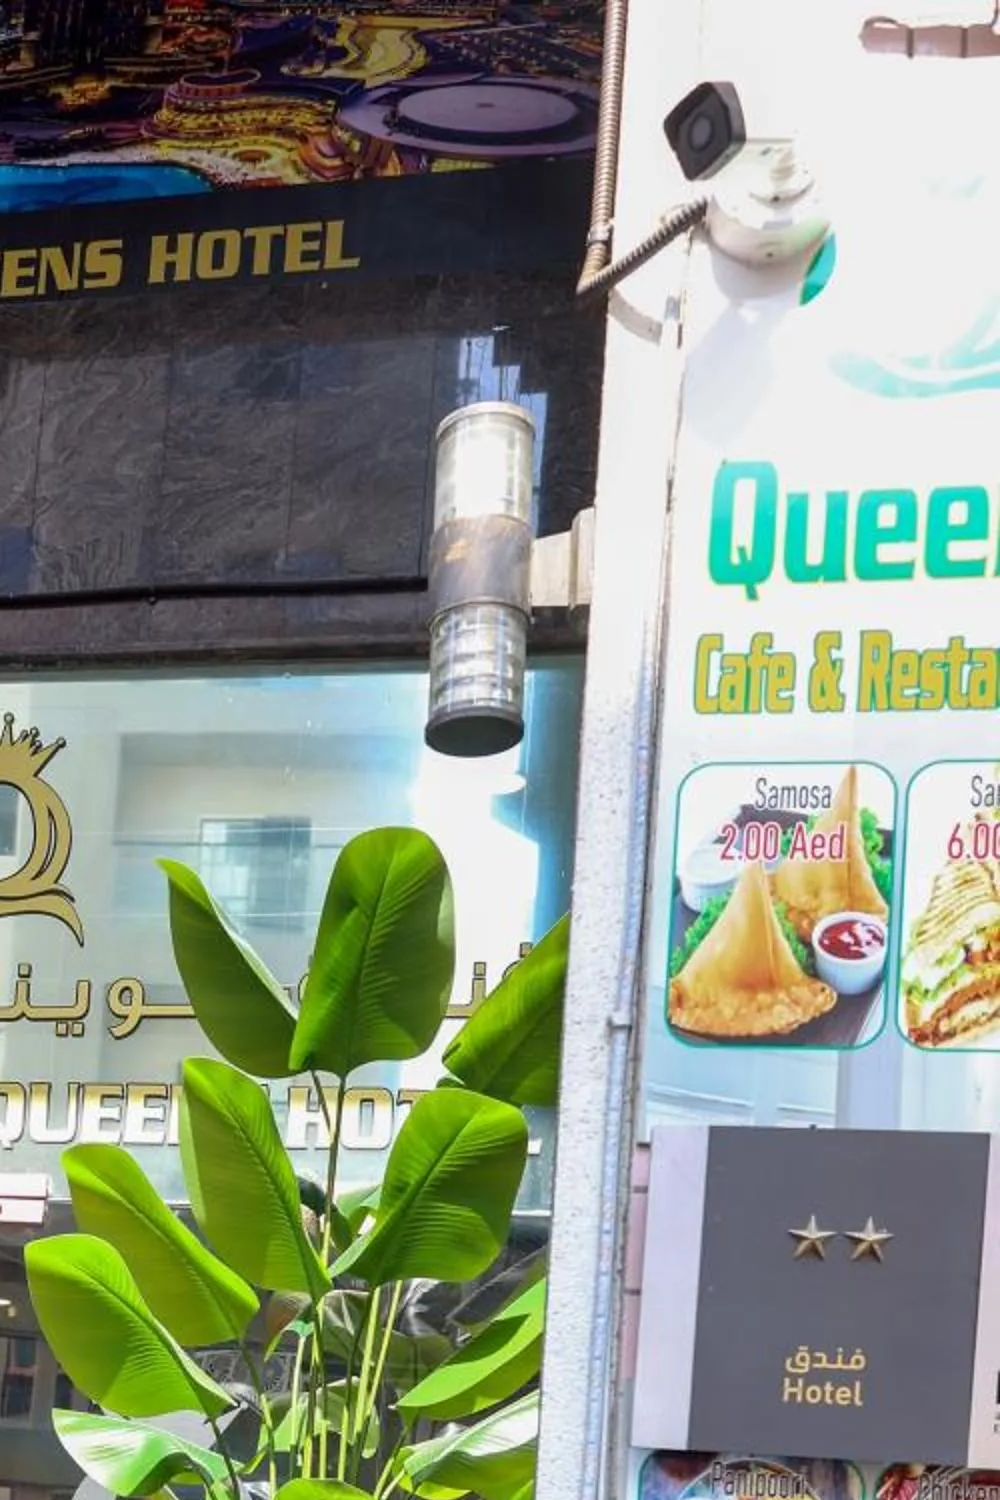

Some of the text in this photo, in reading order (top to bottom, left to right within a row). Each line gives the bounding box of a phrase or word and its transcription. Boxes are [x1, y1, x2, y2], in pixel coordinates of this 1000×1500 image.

[147, 220, 362, 283] HOTEL
[708, 460, 1000, 601] Quee
[694, 631, 797, 715] Cafe
[808, 631, 846, 713] &
[754, 777, 832, 810] Samosa
[969, 774, 1000, 808] Sa
[719, 823, 845, 861] 2.00 Aed
[784, 1345, 867, 1374] فندق
[782, 1377, 863, 1407] Hotel
